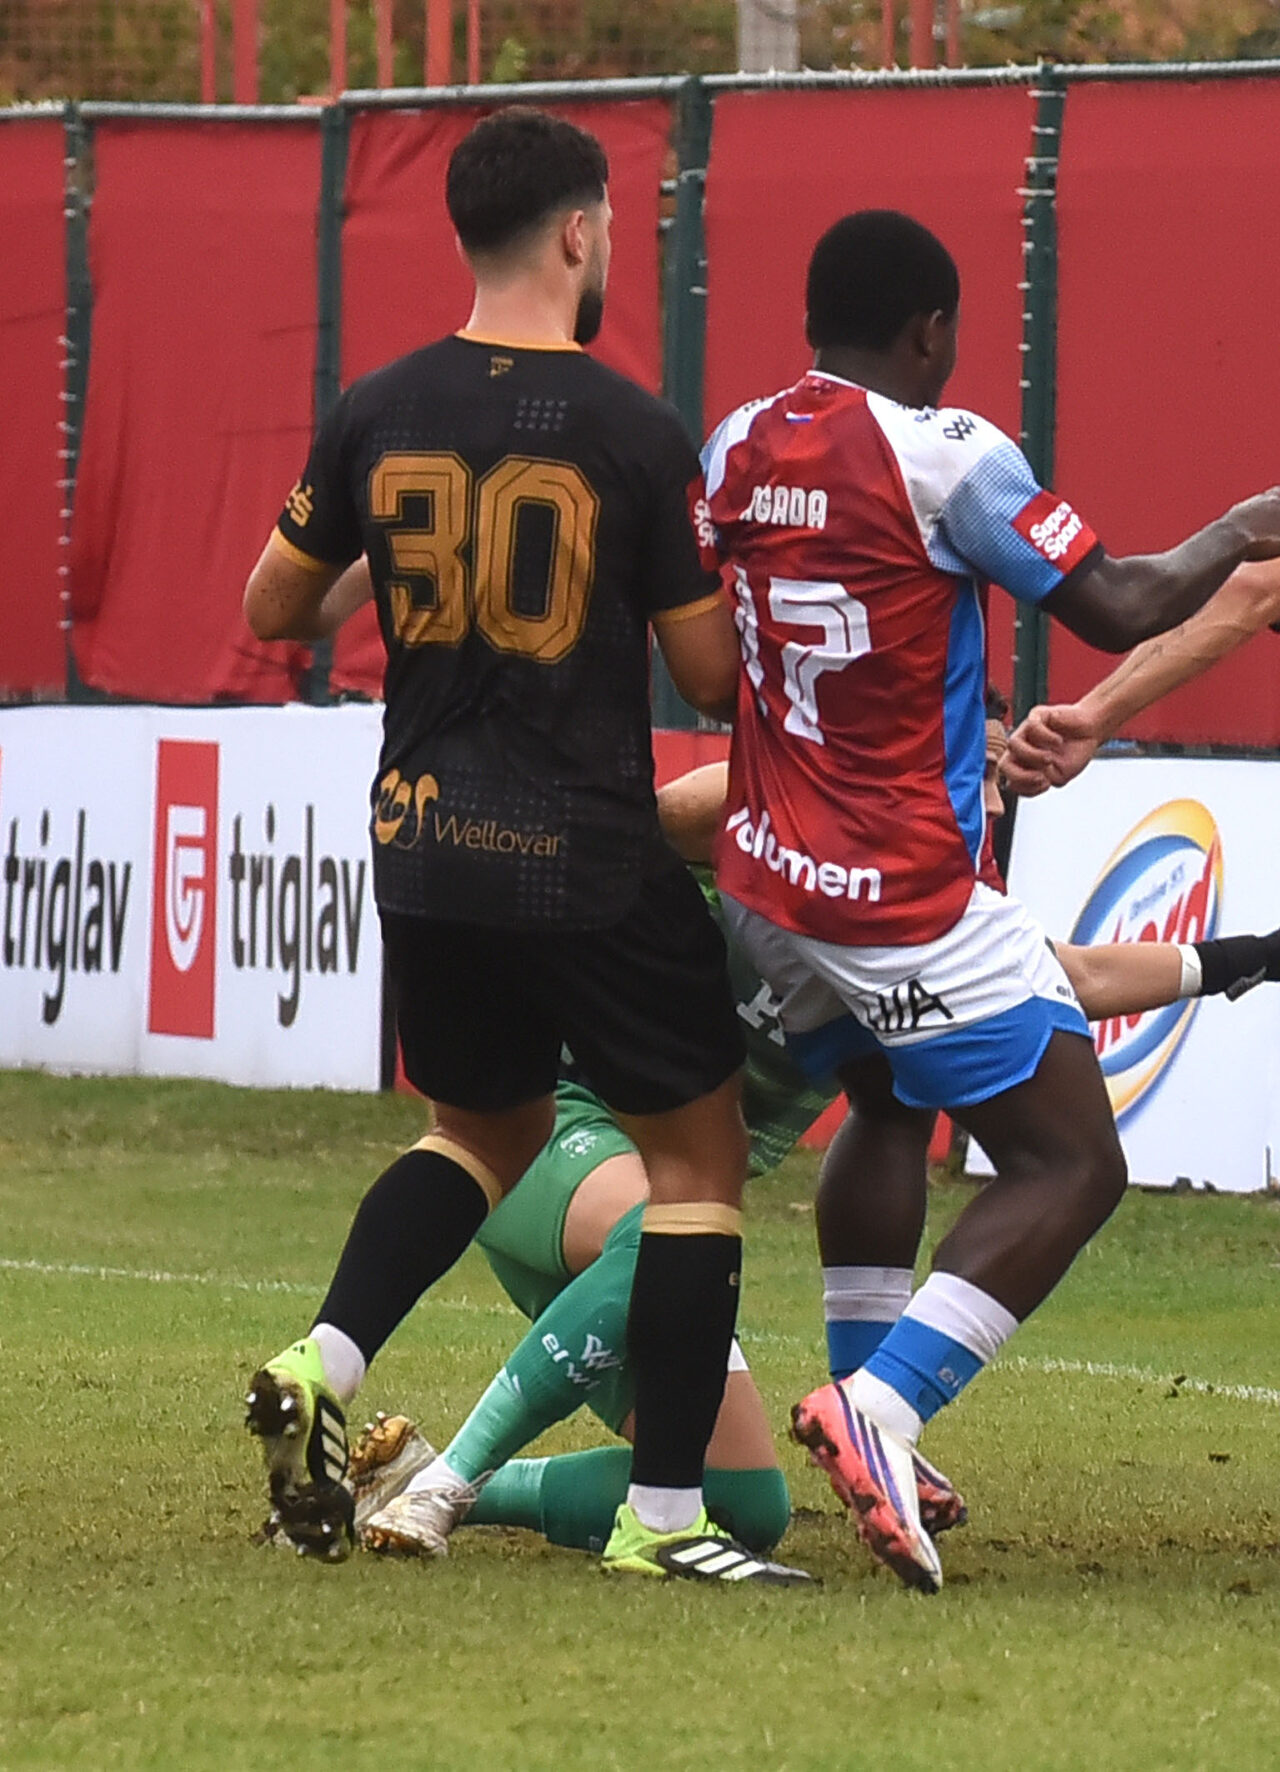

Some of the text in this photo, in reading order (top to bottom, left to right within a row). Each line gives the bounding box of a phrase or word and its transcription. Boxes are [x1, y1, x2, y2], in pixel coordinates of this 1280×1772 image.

[369, 450, 601, 665] 30
[732, 563, 873, 747] 17
[2, 808, 132, 1025] triglav
[229, 803, 366, 1028] triglav
[434, 811, 562, 857] Wellovar
